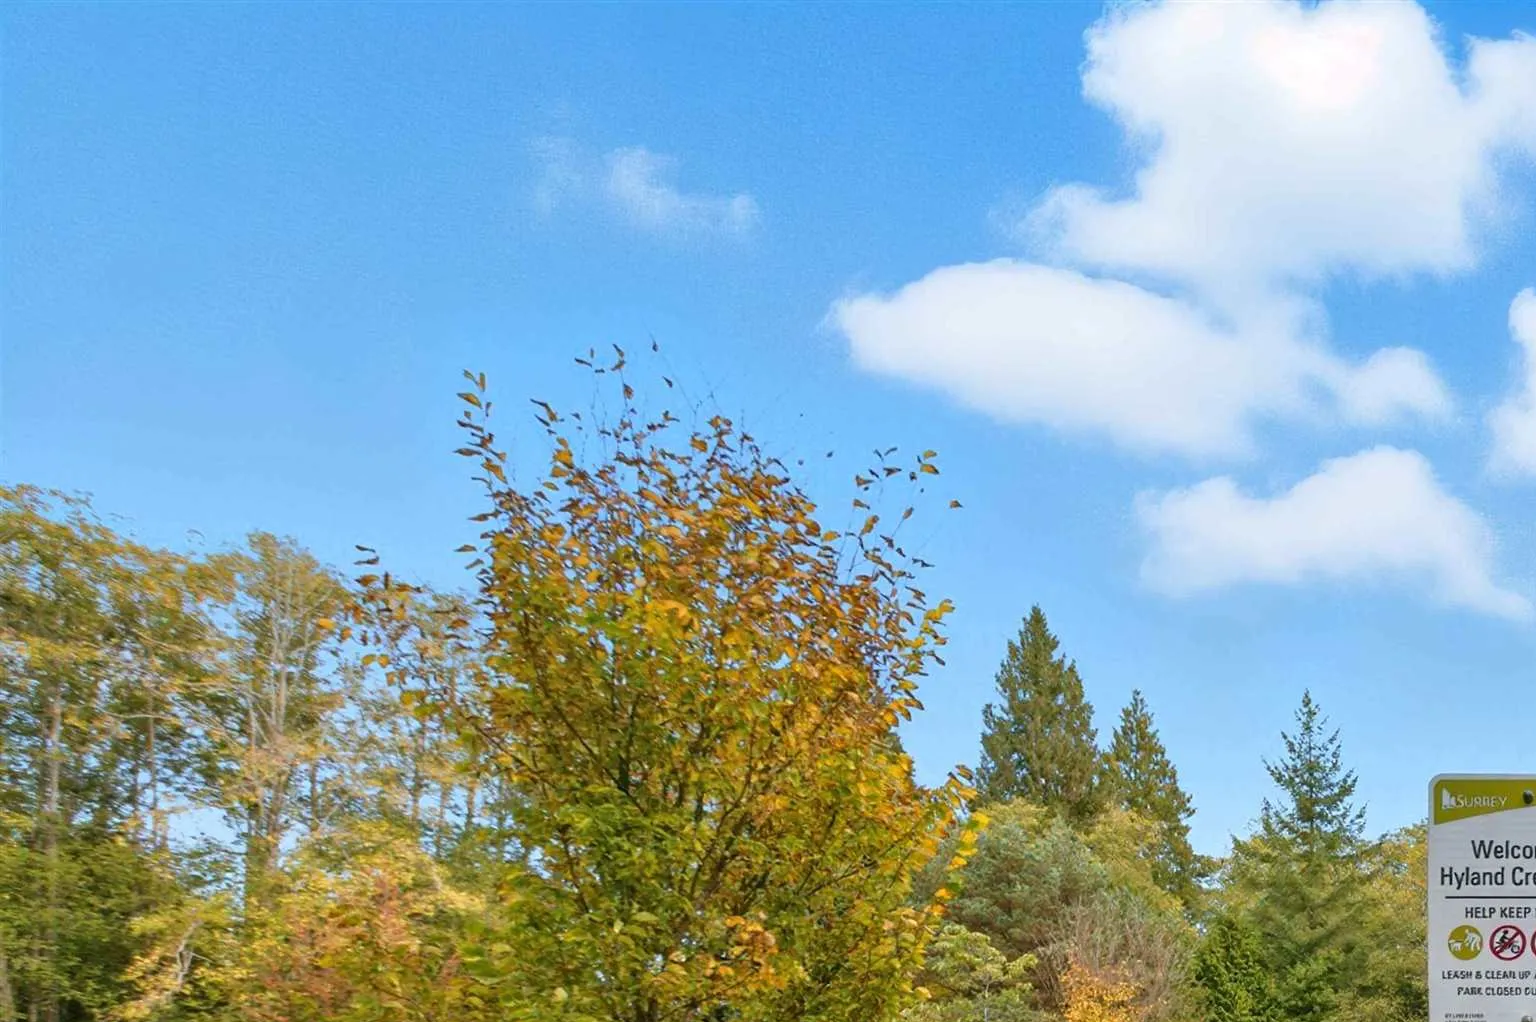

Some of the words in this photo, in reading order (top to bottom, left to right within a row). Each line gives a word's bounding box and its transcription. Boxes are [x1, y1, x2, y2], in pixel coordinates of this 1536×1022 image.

[1455, 794, 1508, 808] SURREY
[1440, 866, 1505, 890] Hyland
[1464, 906, 1496, 919] HELP
[1500, 906, 1531, 919] KEEP
[1441, 970, 1473, 980] LEASH
[1475, 970, 1483, 980] &
[1485, 970, 1516, 980] CLEAN
[1518, 970, 1532, 980] UP
[1457, 986, 1483, 996] PARK
[1484, 986, 1522, 996] CLOSED
